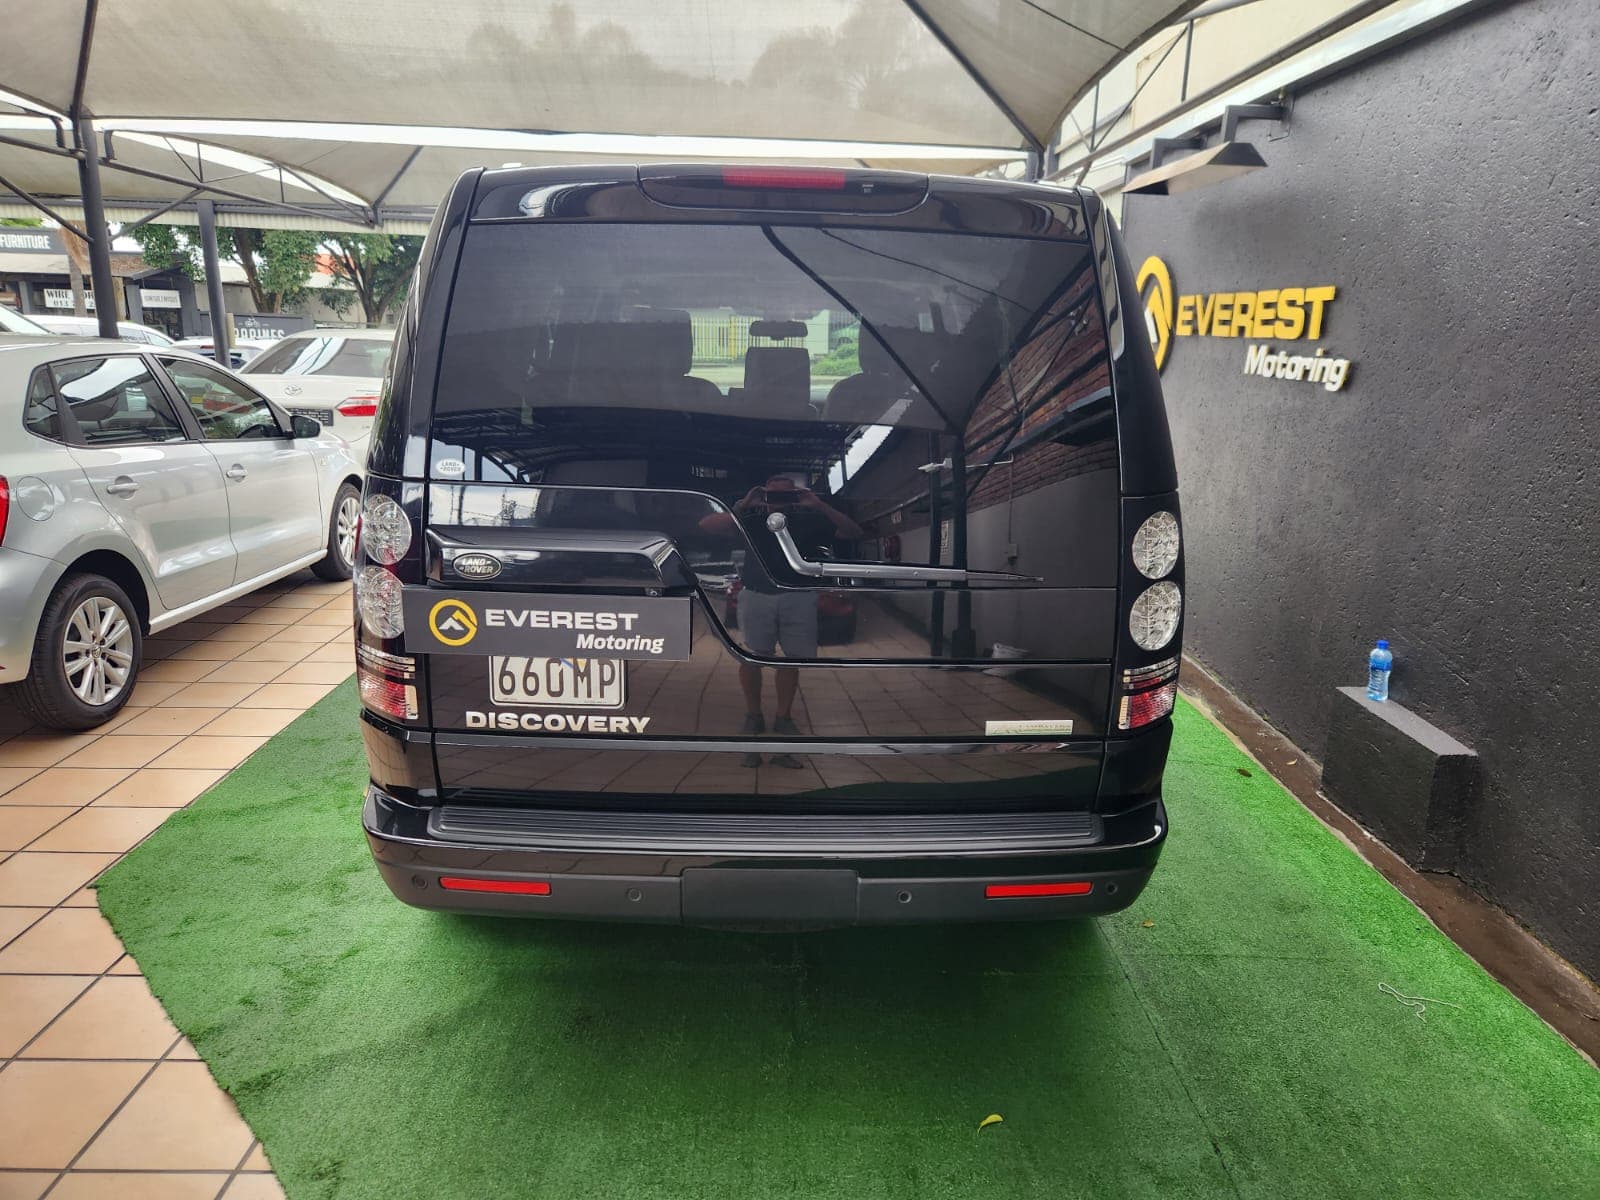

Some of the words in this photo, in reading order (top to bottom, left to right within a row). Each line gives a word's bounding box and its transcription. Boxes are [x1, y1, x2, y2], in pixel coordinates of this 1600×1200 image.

[1175, 286, 1336, 340] EVEREST
[1244, 345, 1350, 391] Motoring
[485, 608, 639, 631] EVEREST
[576, 634, 665, 654] Motoring
[465, 711, 651, 734] DISCOVERY
